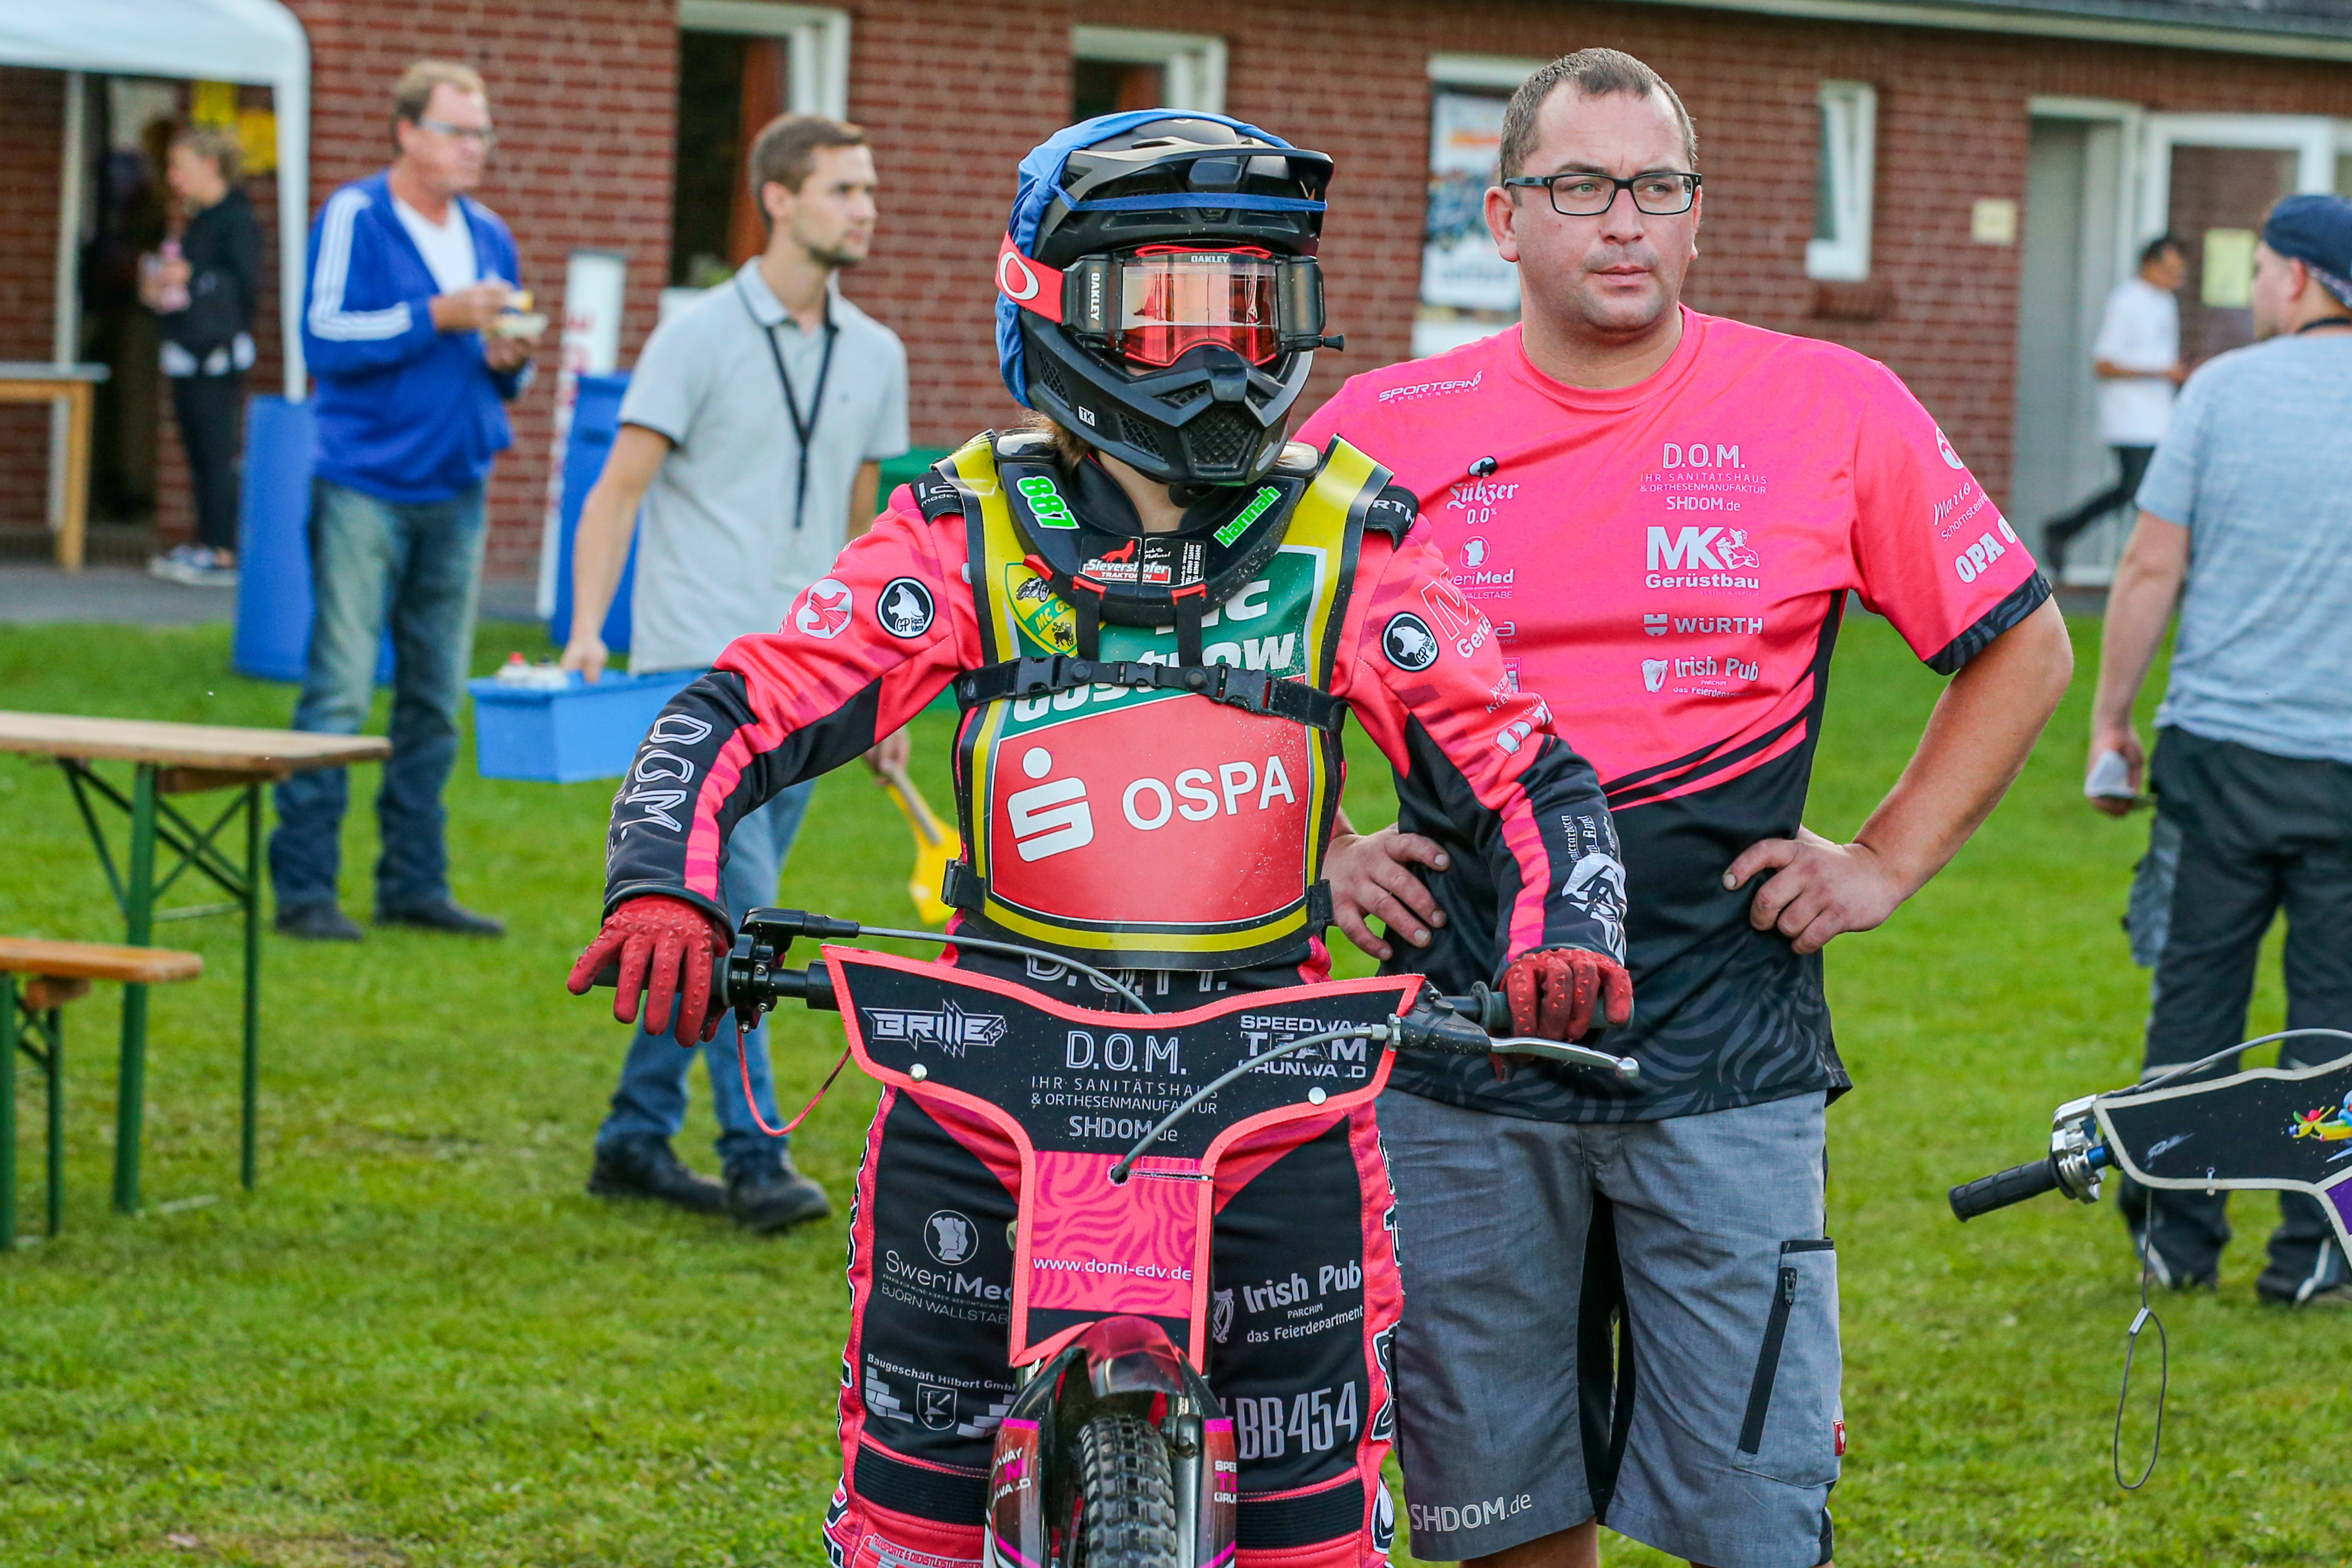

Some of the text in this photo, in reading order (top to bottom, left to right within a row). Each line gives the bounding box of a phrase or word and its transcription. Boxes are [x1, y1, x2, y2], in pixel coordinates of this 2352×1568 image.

[1190, 255, 1229, 263] OAKLEY
[1090, 272, 1101, 321] OAKLEY
[1379, 370, 1483, 403] SPORTGANG
[1389, 386, 1479, 404] SPORTSWEAR
[1079, 408, 1093, 424] TK
[1663, 443, 1746, 469] D.O.M.
[1640, 472, 1767, 484] IHR SANITÄTSHAUS
[1640, 483, 1767, 494] & ORTHESENMANUFAKTUR
[1016, 476, 1080, 529] 887
[1214, 486, 1281, 548] Hannah
[1666, 496, 1741, 512] SHDOM.de
[1933, 482, 1971, 526] Mario
[1647, 526, 1725, 571] MK
[1954, 531, 2006, 583] OPA
[1451, 568, 1514, 585] eriMed
[1645, 573, 1759, 589] Gerüstbau
[1675, 656, 1759, 681] Irish Pub
[620, 714, 713, 840] D.O.M.
[1122, 755, 1296, 830] OSPA
[1066, 1030, 1187, 1075] D.O.M.
[1031, 1093, 1040, 1105] &
[1032, 1076, 1063, 1089] IHR
[1033, 1258, 1192, 1281] www.domi-edv.de
[1243, 1260, 1362, 1313] Irish Pub
[882, 1283, 1008, 1325] BJÖRN WALLSTAB
[1287, 1303, 1323, 1319] PARCHIM
[1247, 1305, 1364, 1343] das Feierdepartment
[867, 1353, 935, 1382] Baugeschäft
[938, 1374, 981, 1389] Hilbert
[1411, 1494, 1533, 1531] SHDOM.de
